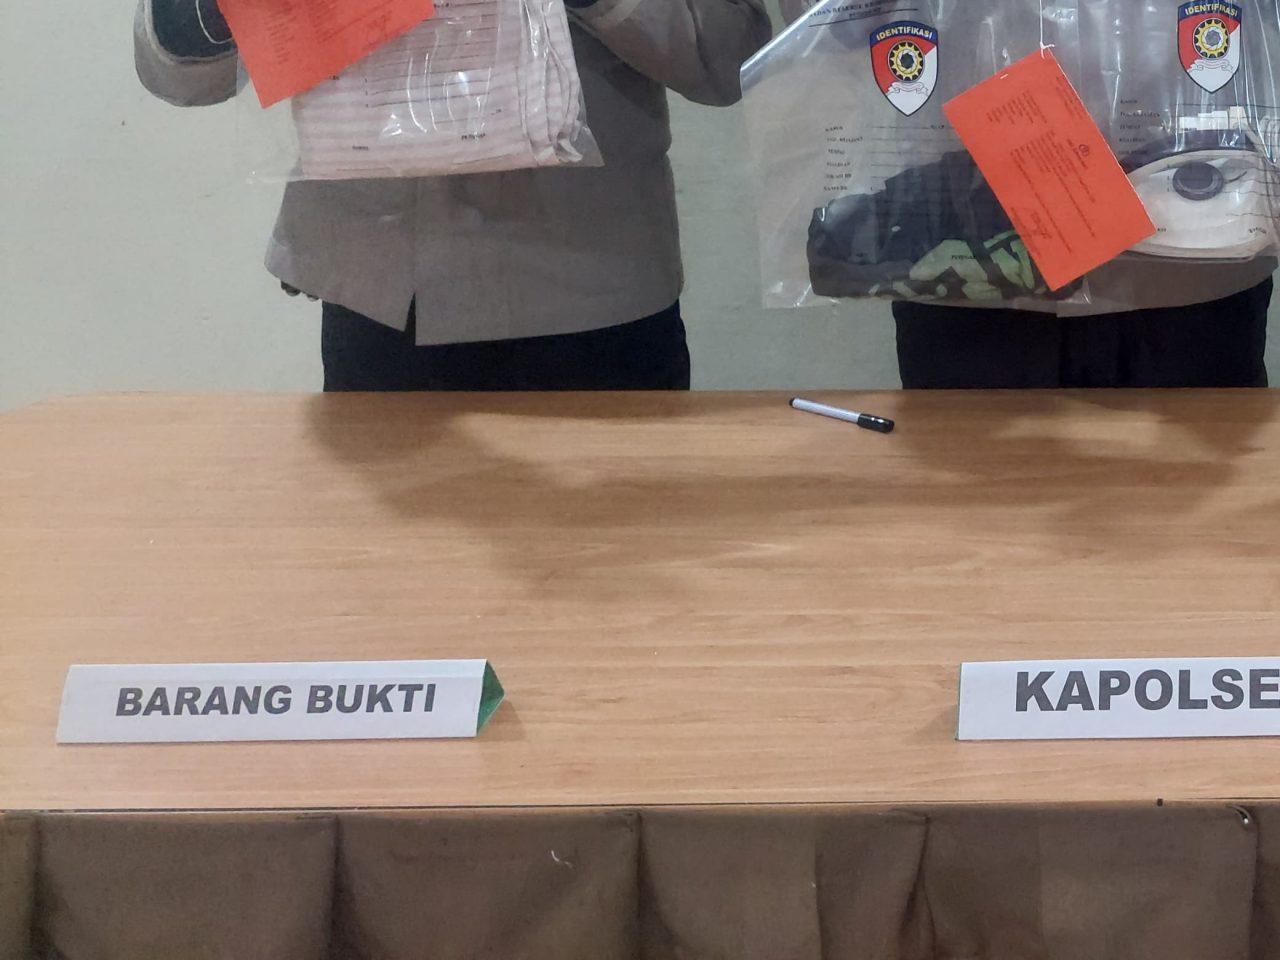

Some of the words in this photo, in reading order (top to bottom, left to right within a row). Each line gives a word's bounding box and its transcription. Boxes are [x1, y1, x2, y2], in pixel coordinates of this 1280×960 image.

[876, 26, 932, 41] IDENTIFIKASI
[115, 684, 293, 717] BARANG
[305, 683, 437, 714] BUKTI
